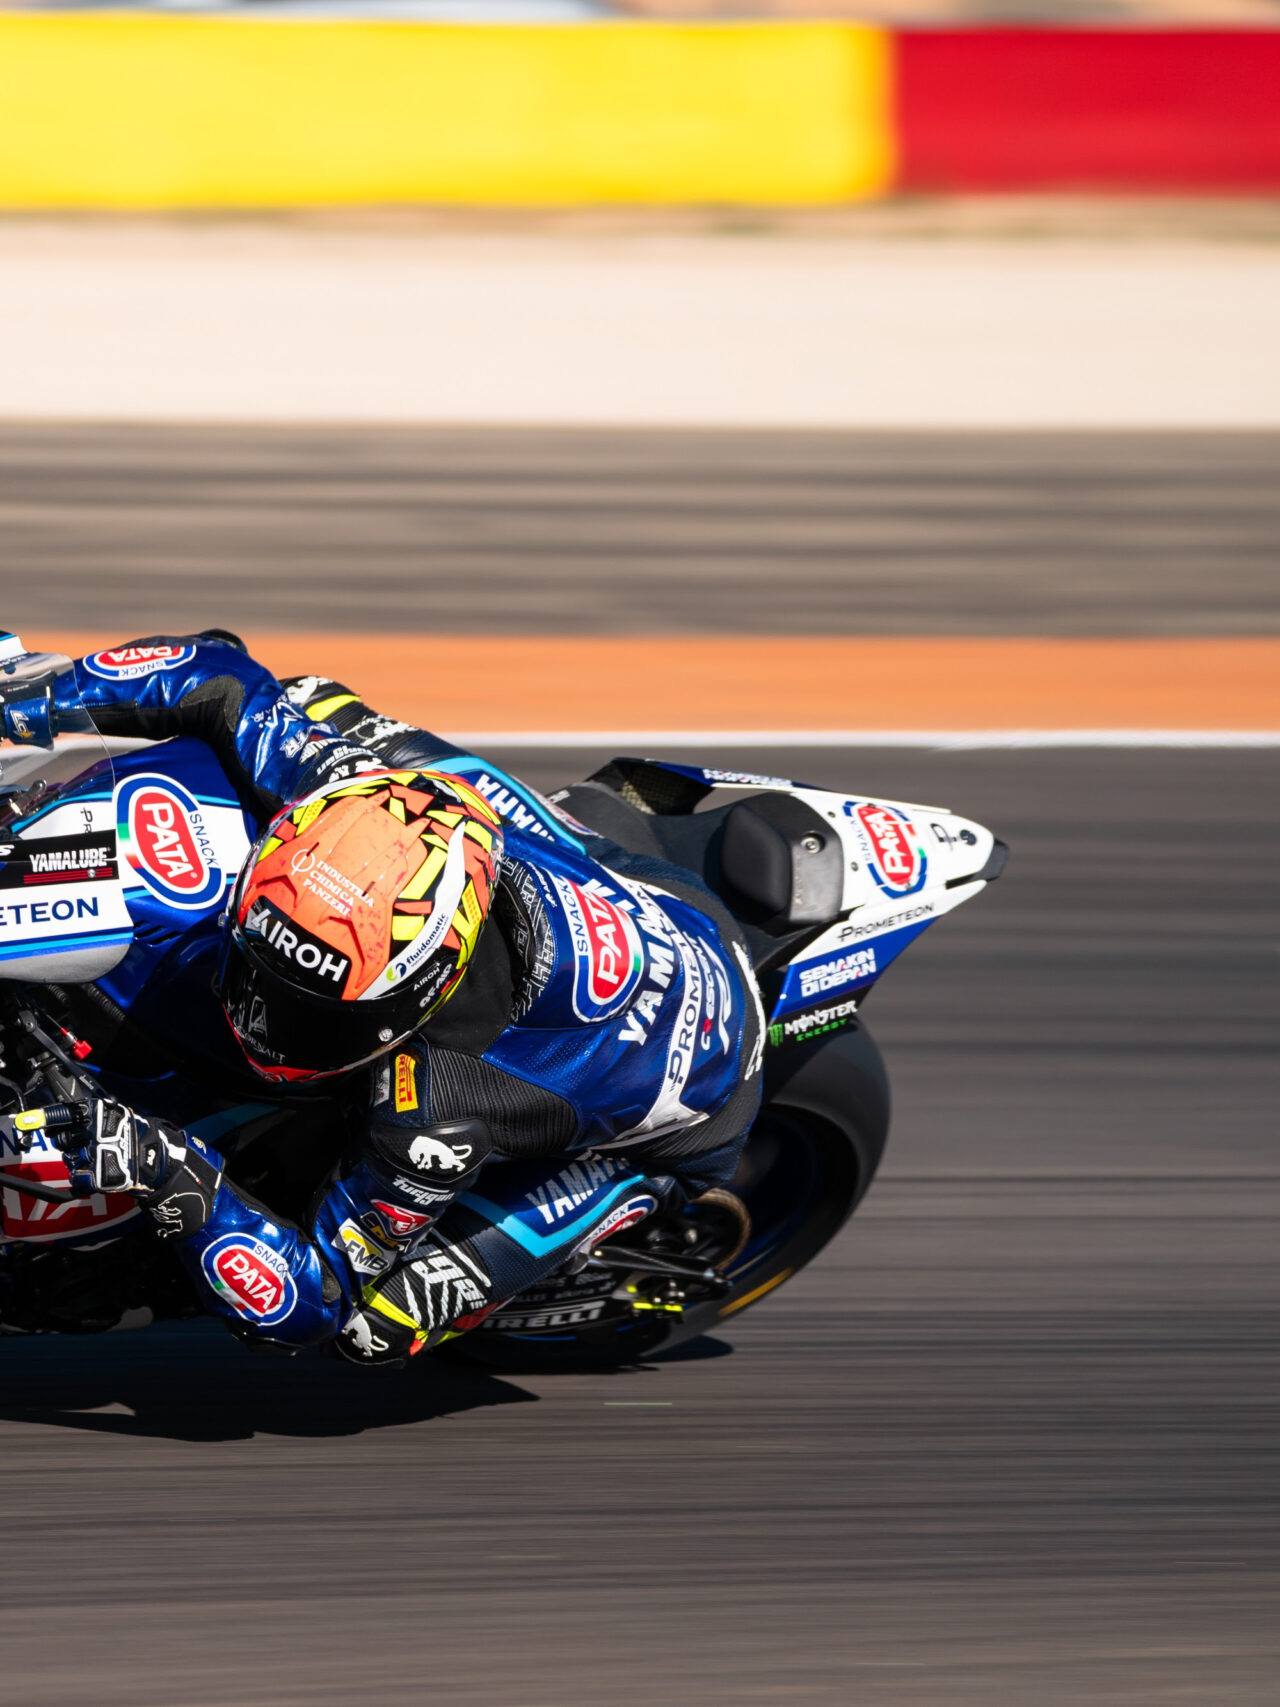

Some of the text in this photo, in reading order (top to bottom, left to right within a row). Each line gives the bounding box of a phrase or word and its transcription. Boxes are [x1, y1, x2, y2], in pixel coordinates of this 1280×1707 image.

[108, 645, 173, 663] PATA
[121, 660, 164, 678] SNACK
[142, 802, 194, 878] PATA
[189, 813, 219, 870] SNACK
[29, 849, 108, 872] YAMALUBE
[302, 878, 352, 917] PANZERI
[309, 869, 355, 906] CHIMICA
[316, 859, 375, 908] INDUSTRIA
[405, 911, 448, 965] fluidomatic
[838, 903, 934, 941] PROMETEON
[250, 907, 349, 982] AIROH
[413, 966, 440, 991] AIROH
[799, 948, 875, 985] SEMAKIN
[801, 960, 877, 998] DI DEPAN
[784, 1000, 858, 1035] MONSTER
[796, 1018, 847, 1042] ENERGY
[222, 1253, 279, 1310] PATA
[488, 1300, 606, 1330] IRELLI
